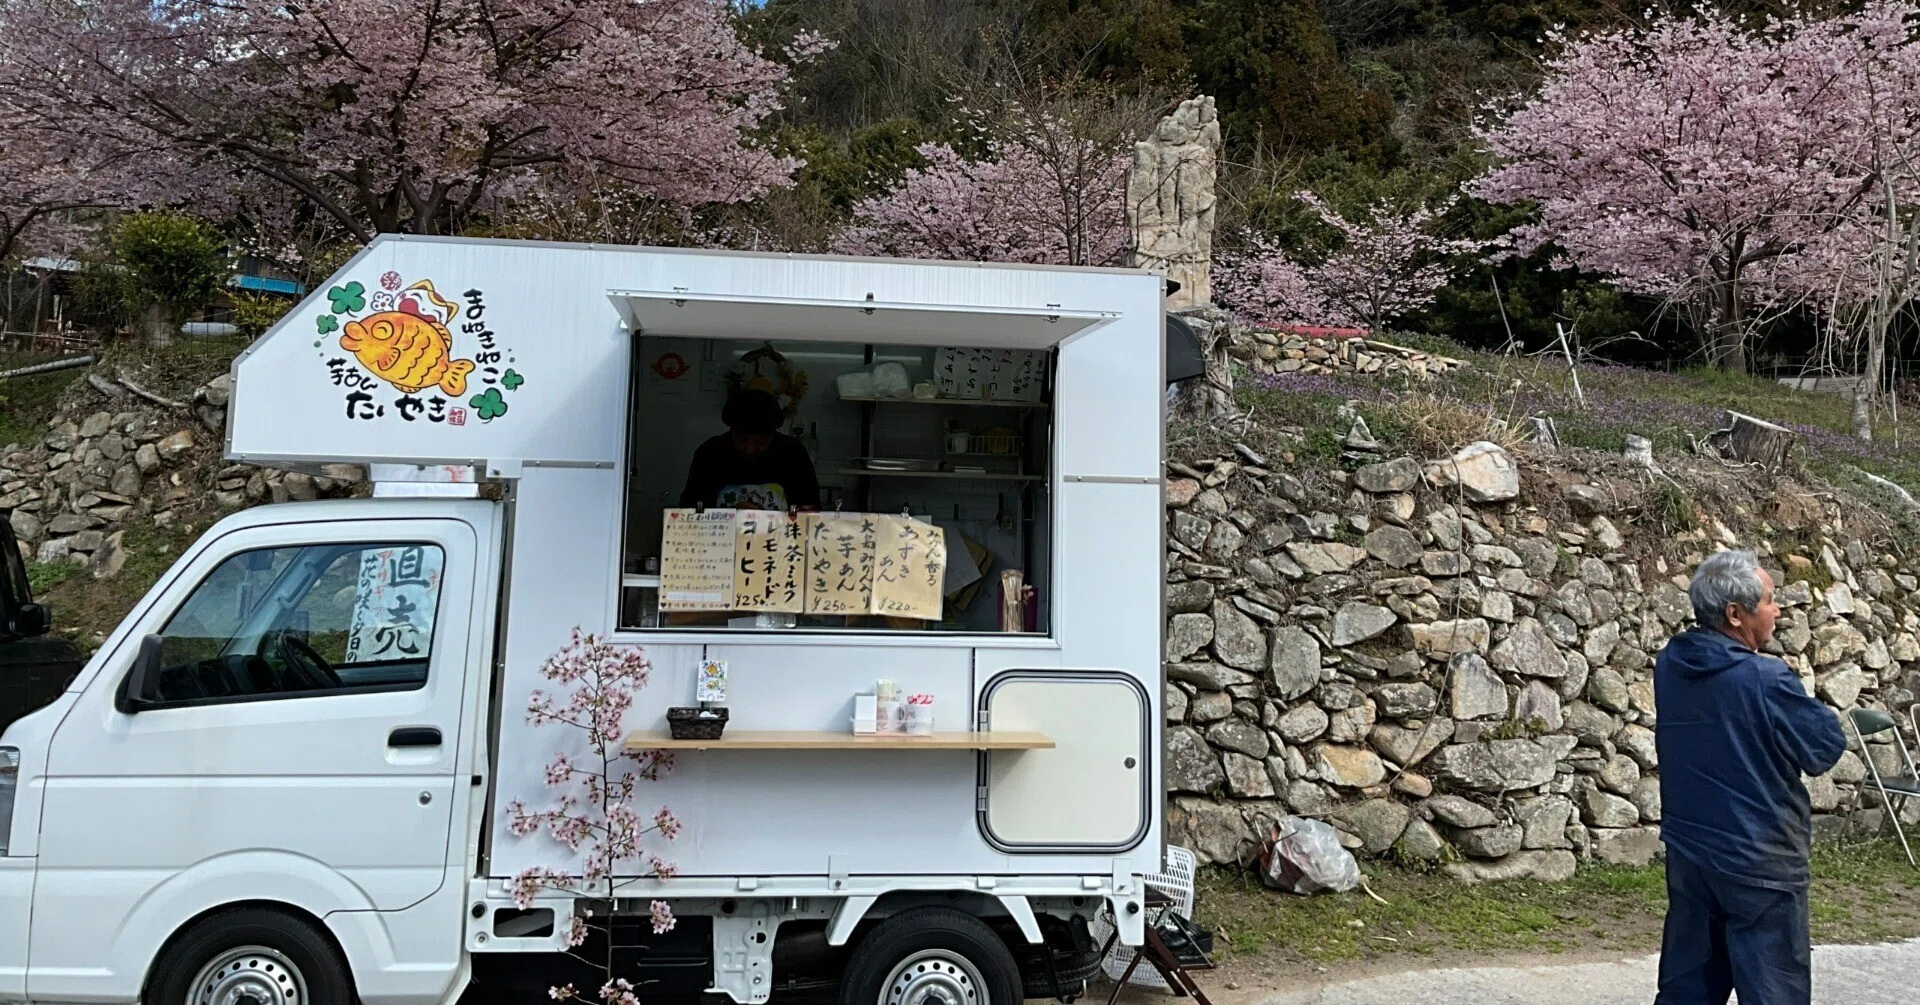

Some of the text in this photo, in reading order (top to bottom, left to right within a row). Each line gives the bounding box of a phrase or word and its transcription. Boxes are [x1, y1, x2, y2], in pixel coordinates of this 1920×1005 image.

[326, 357, 378, 392] 芋あん
[346, 390, 447, 423] たいやき
[741, 521, 757, 587] コーヒー
[763, 521, 780, 599] レモネード
[813, 521, 831, 593] たいやき
[837, 535, 856, 592] 芋あん
[372, 546, 431, 654] 直売
